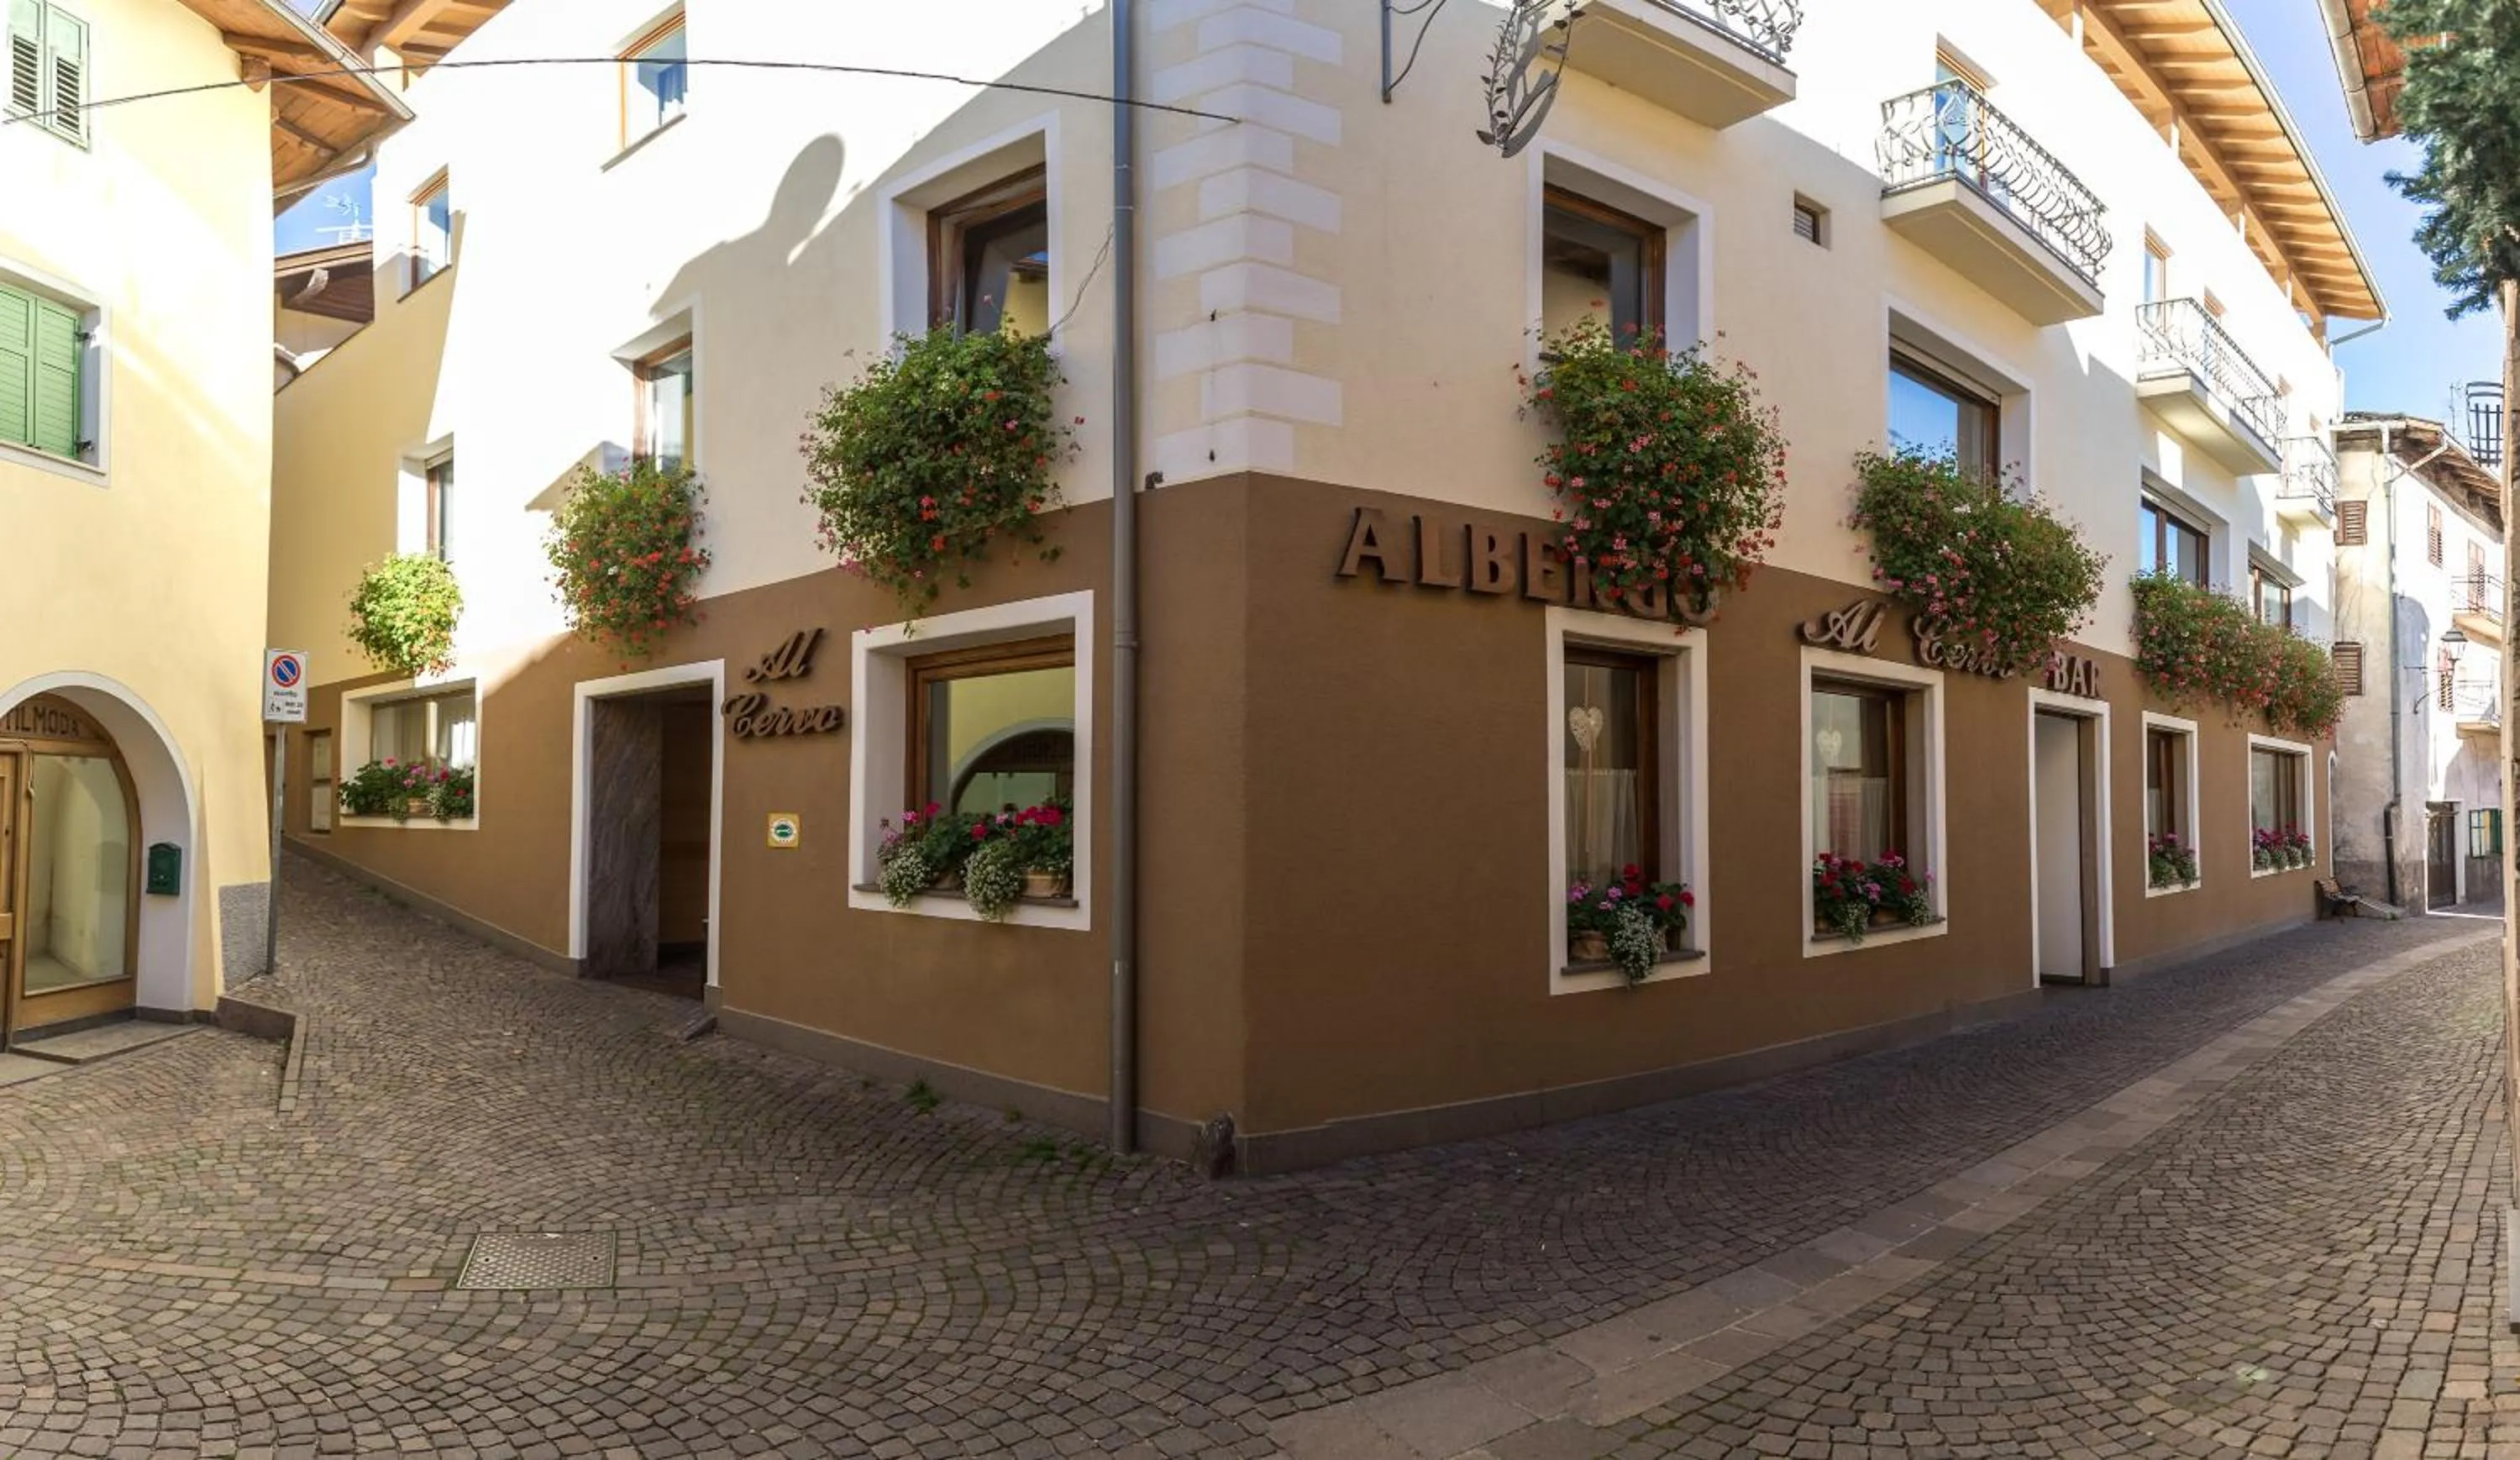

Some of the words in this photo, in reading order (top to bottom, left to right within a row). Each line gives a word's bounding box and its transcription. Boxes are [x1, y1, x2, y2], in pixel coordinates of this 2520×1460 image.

[1799, 597, 1890, 653] Al
[742, 628, 825, 683] Al
[2051, 650, 2102, 698] BAR
[722, 692, 843, 738] Cervo
